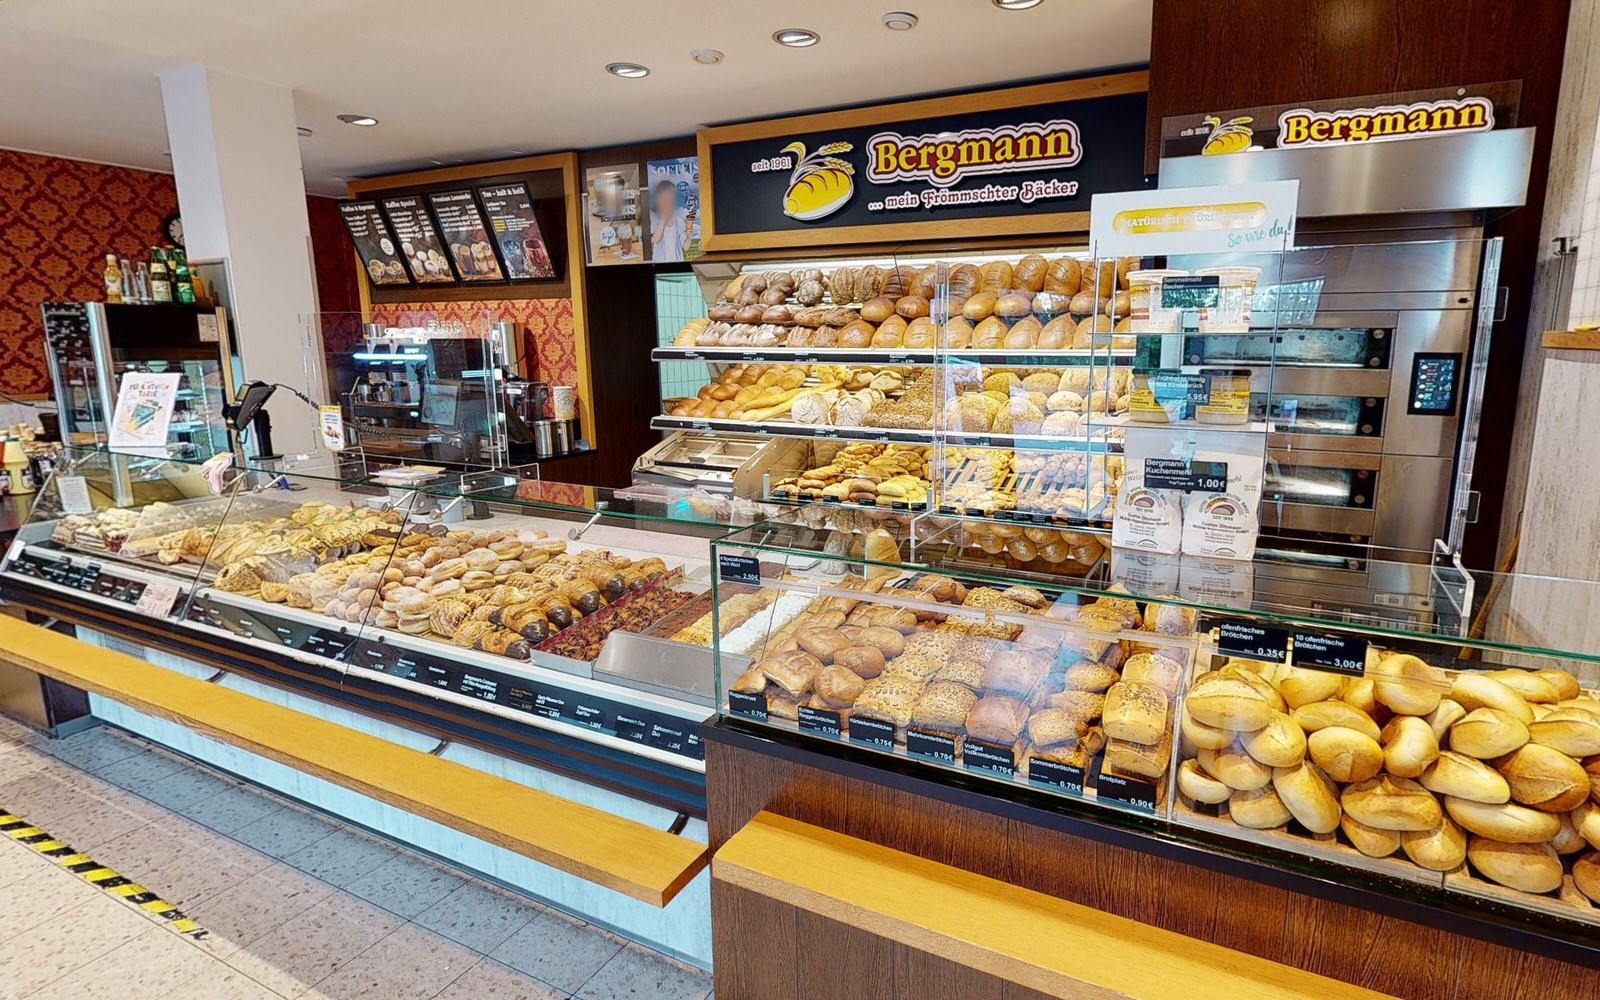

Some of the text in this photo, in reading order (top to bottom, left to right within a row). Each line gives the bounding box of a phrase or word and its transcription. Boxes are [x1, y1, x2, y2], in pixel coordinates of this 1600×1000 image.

[1285, 101, 1484, 143] Bergmann
[872, 126, 1074, 178] Bergmann
[651, 163, 699, 176] SOFTEIS
[751, 156, 792, 172] seit 1961
[886, 193, 918, 208] mein
[921, 185, 1018, 208] Frömmschter
[1021, 181, 1078, 203] Bäcker
[1187, 376, 1206, 384] Honig
[1146, 466, 1193, 476] Kuchenmehl
[1198, 478, 1226, 489] 1,00€
[1220, 630, 1253, 641] Brötchen
[1221, 623, 1265, 636] ofenfrisches
[1294, 641, 1327, 652] Brötchen
[1295, 634, 1345, 648] 10 ofenfrische
[1334, 658, 1363, 671] 3,00€
[798, 707, 814, 715] Echtes
[799, 713, 836, 725] Roggenbrötchen
[849, 717, 893, 733] Kürbiskernbrötchen
[907, 730, 954, 746] Mehrkornbrötchen
[963, 742, 984, 753] Vollgut
[963, 749, 1010, 764] Vollkornbrötchen
[1030, 758, 1080, 775] Sommerbrötchen
[1098, 774, 1127, 787] Brotplatz
